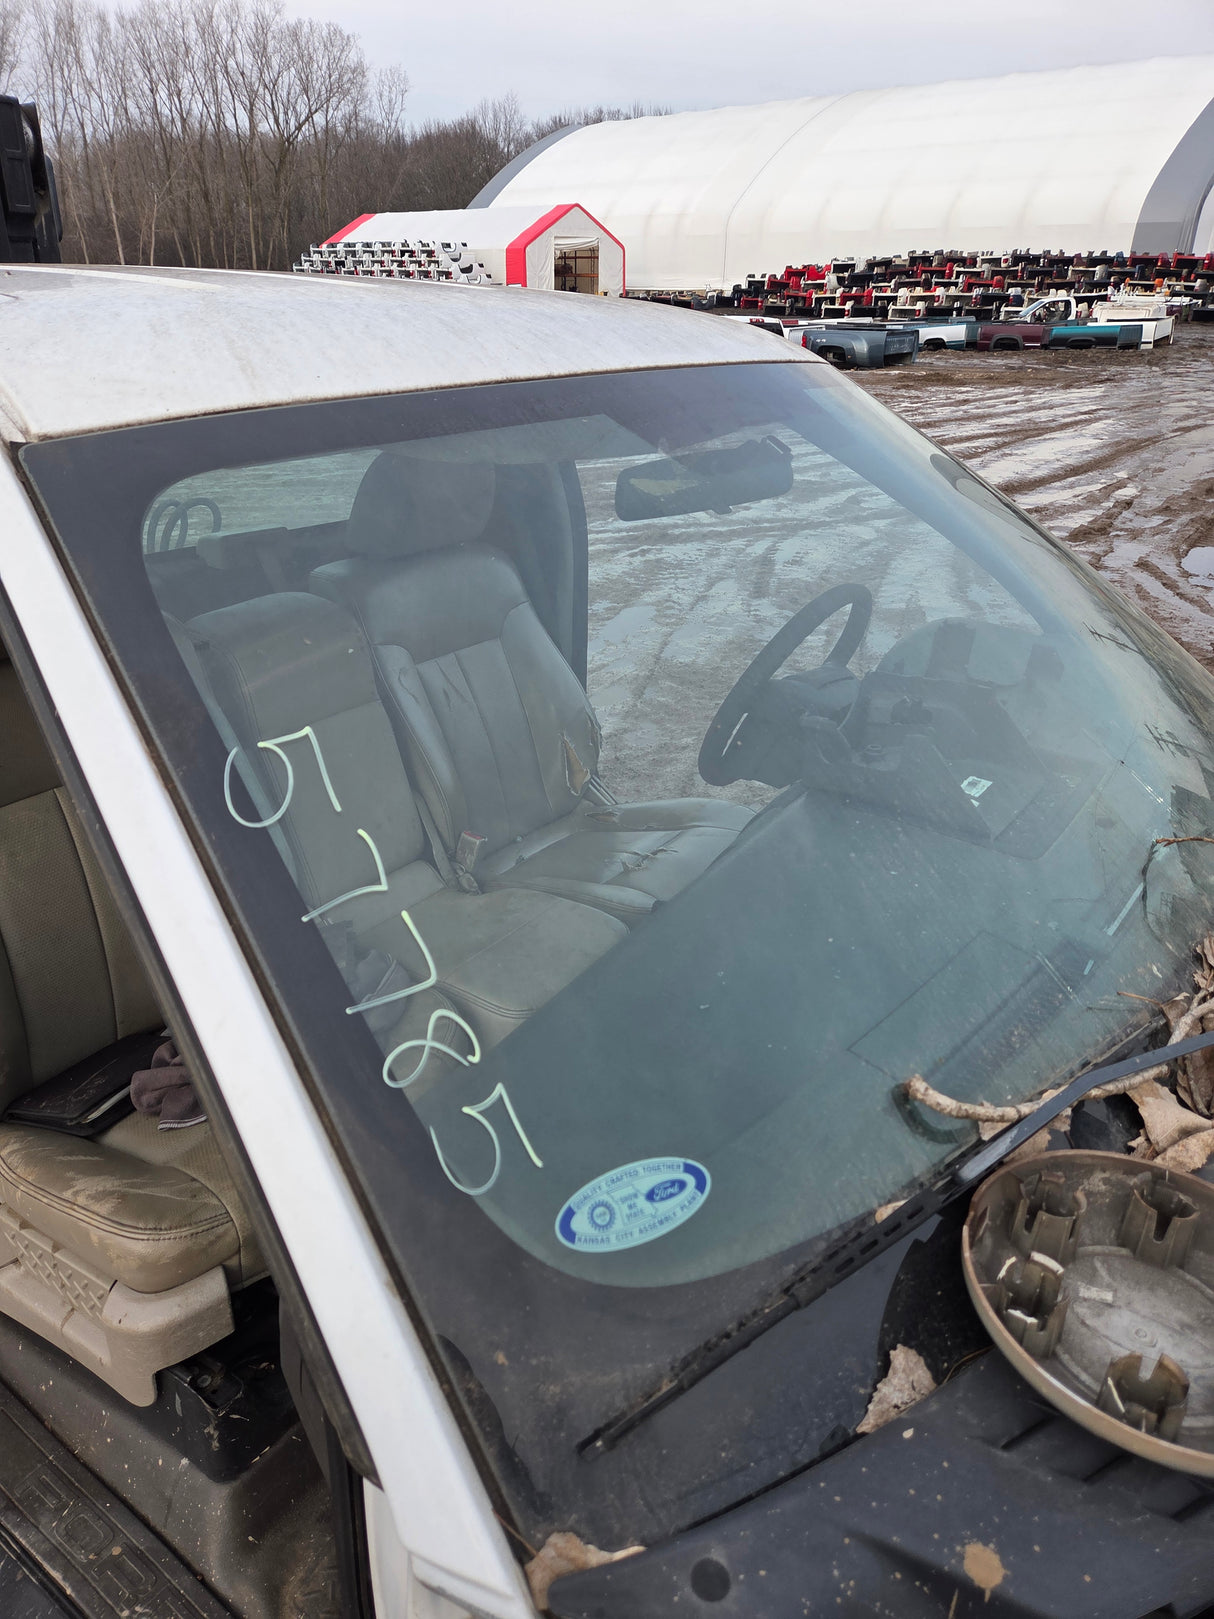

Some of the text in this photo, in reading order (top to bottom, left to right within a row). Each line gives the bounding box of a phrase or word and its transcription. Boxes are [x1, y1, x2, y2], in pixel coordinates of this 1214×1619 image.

[224, 725, 544, 1197] 57785
[604, 1169, 639, 1187] CRAFTED
[642, 1163, 682, 1174] TOGETHER
[653, 1182, 681, 1201] Ford
[576, 1234, 611, 1245] KANSAS
[615, 1230, 634, 1241] CITY
